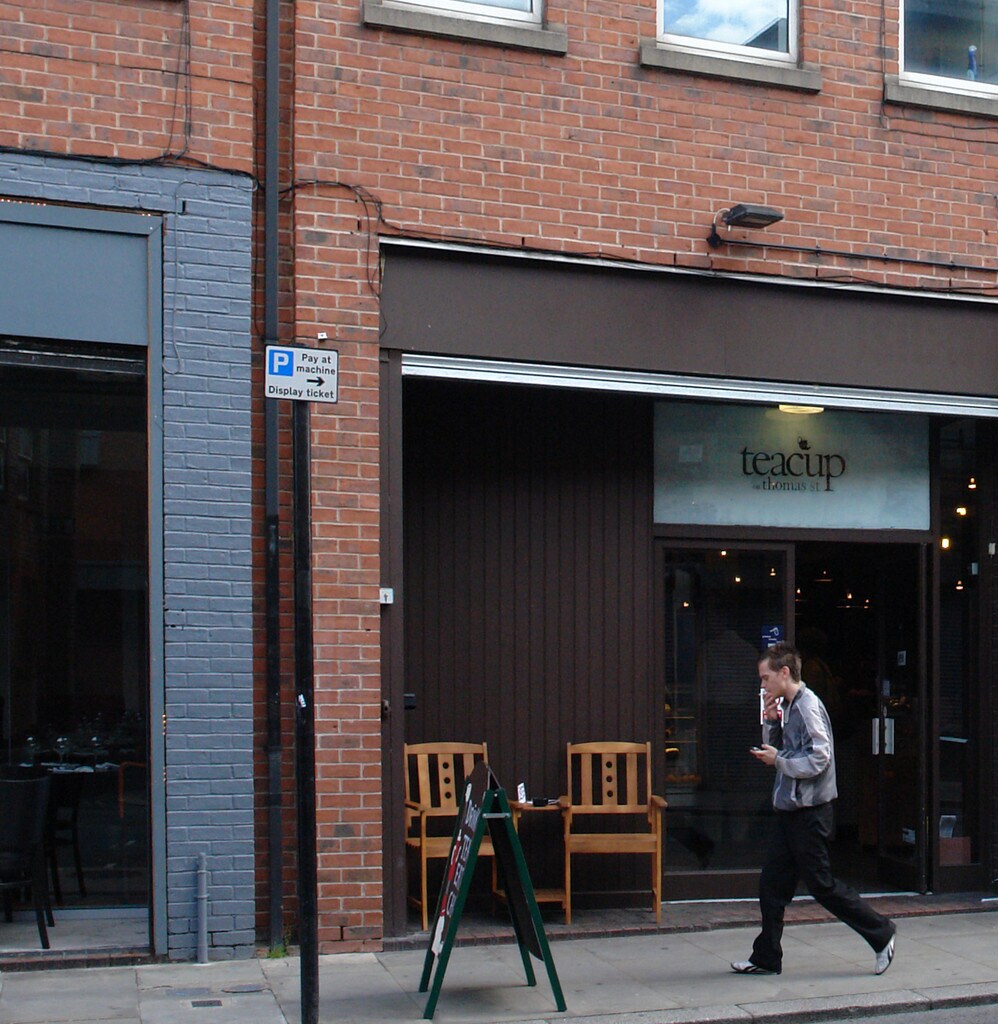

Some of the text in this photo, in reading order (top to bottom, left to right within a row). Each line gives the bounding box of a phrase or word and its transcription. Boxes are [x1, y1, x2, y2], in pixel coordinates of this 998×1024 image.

[273, 352, 289, 373] P
[301, 353, 332, 364] Pay at
[296, 365, 336, 375] machine
[268, 385, 334, 399] Display ticket
[740, 445, 846, 491] teacup
